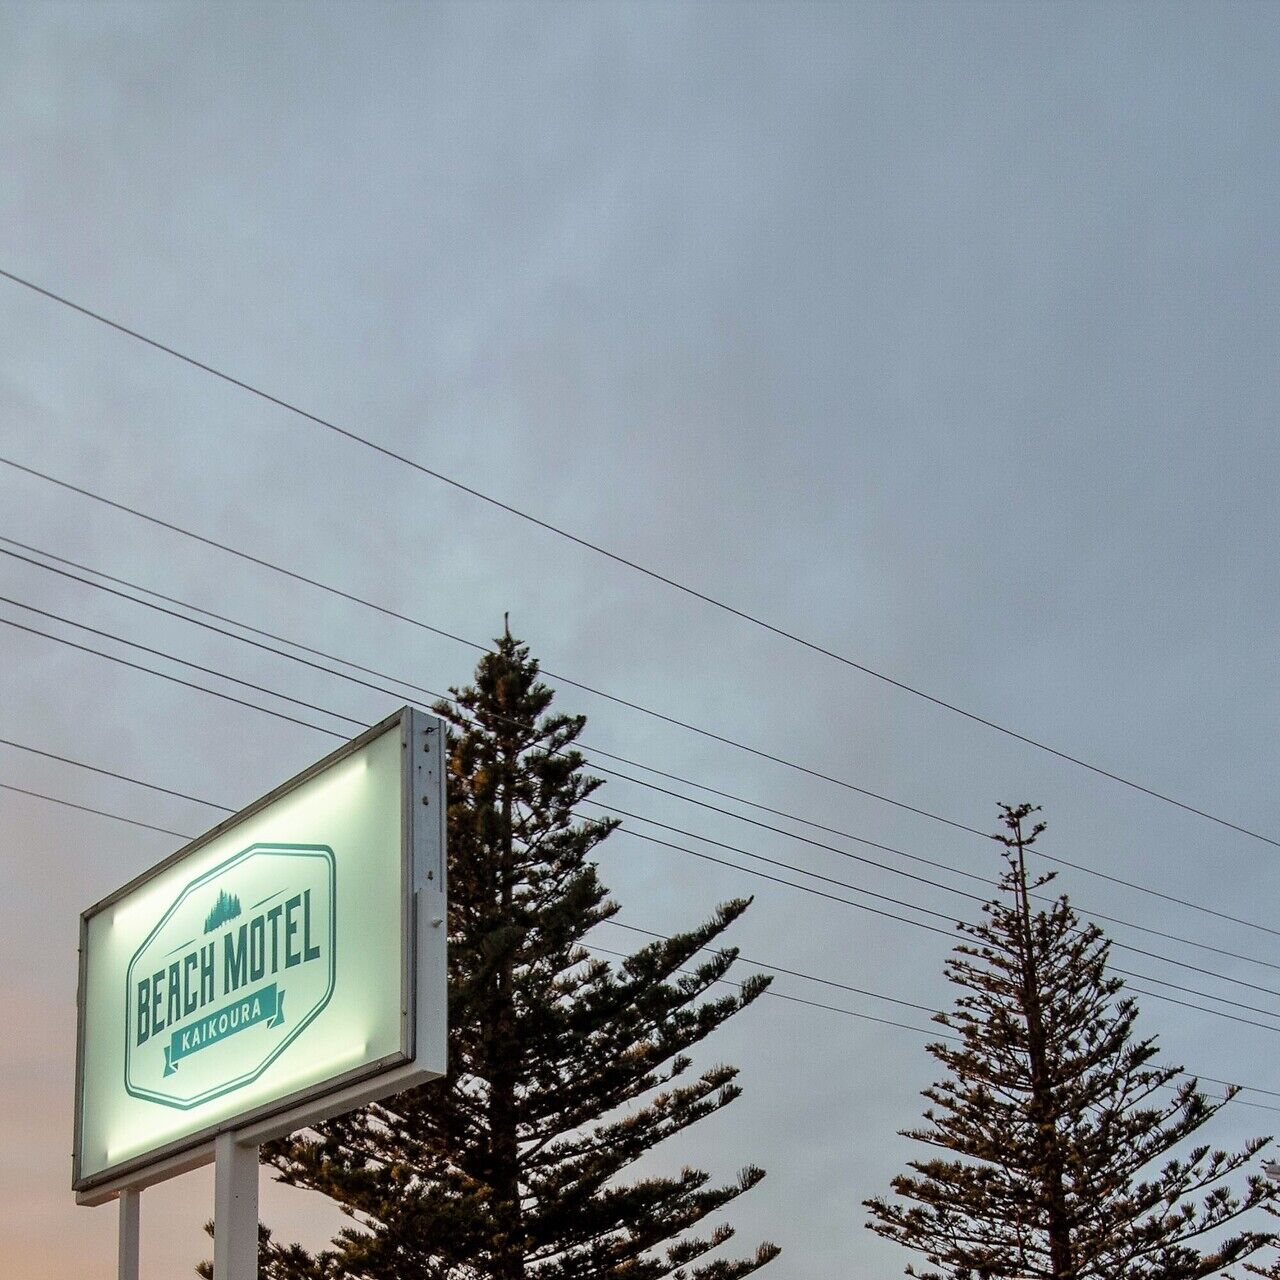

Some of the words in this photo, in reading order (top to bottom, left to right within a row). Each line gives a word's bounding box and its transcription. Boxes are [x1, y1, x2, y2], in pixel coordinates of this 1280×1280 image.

[137, 941, 215, 1047] BEACH
[224, 888, 320, 996] MOTEL
[181, 998, 262, 1051] KAIKOURA
